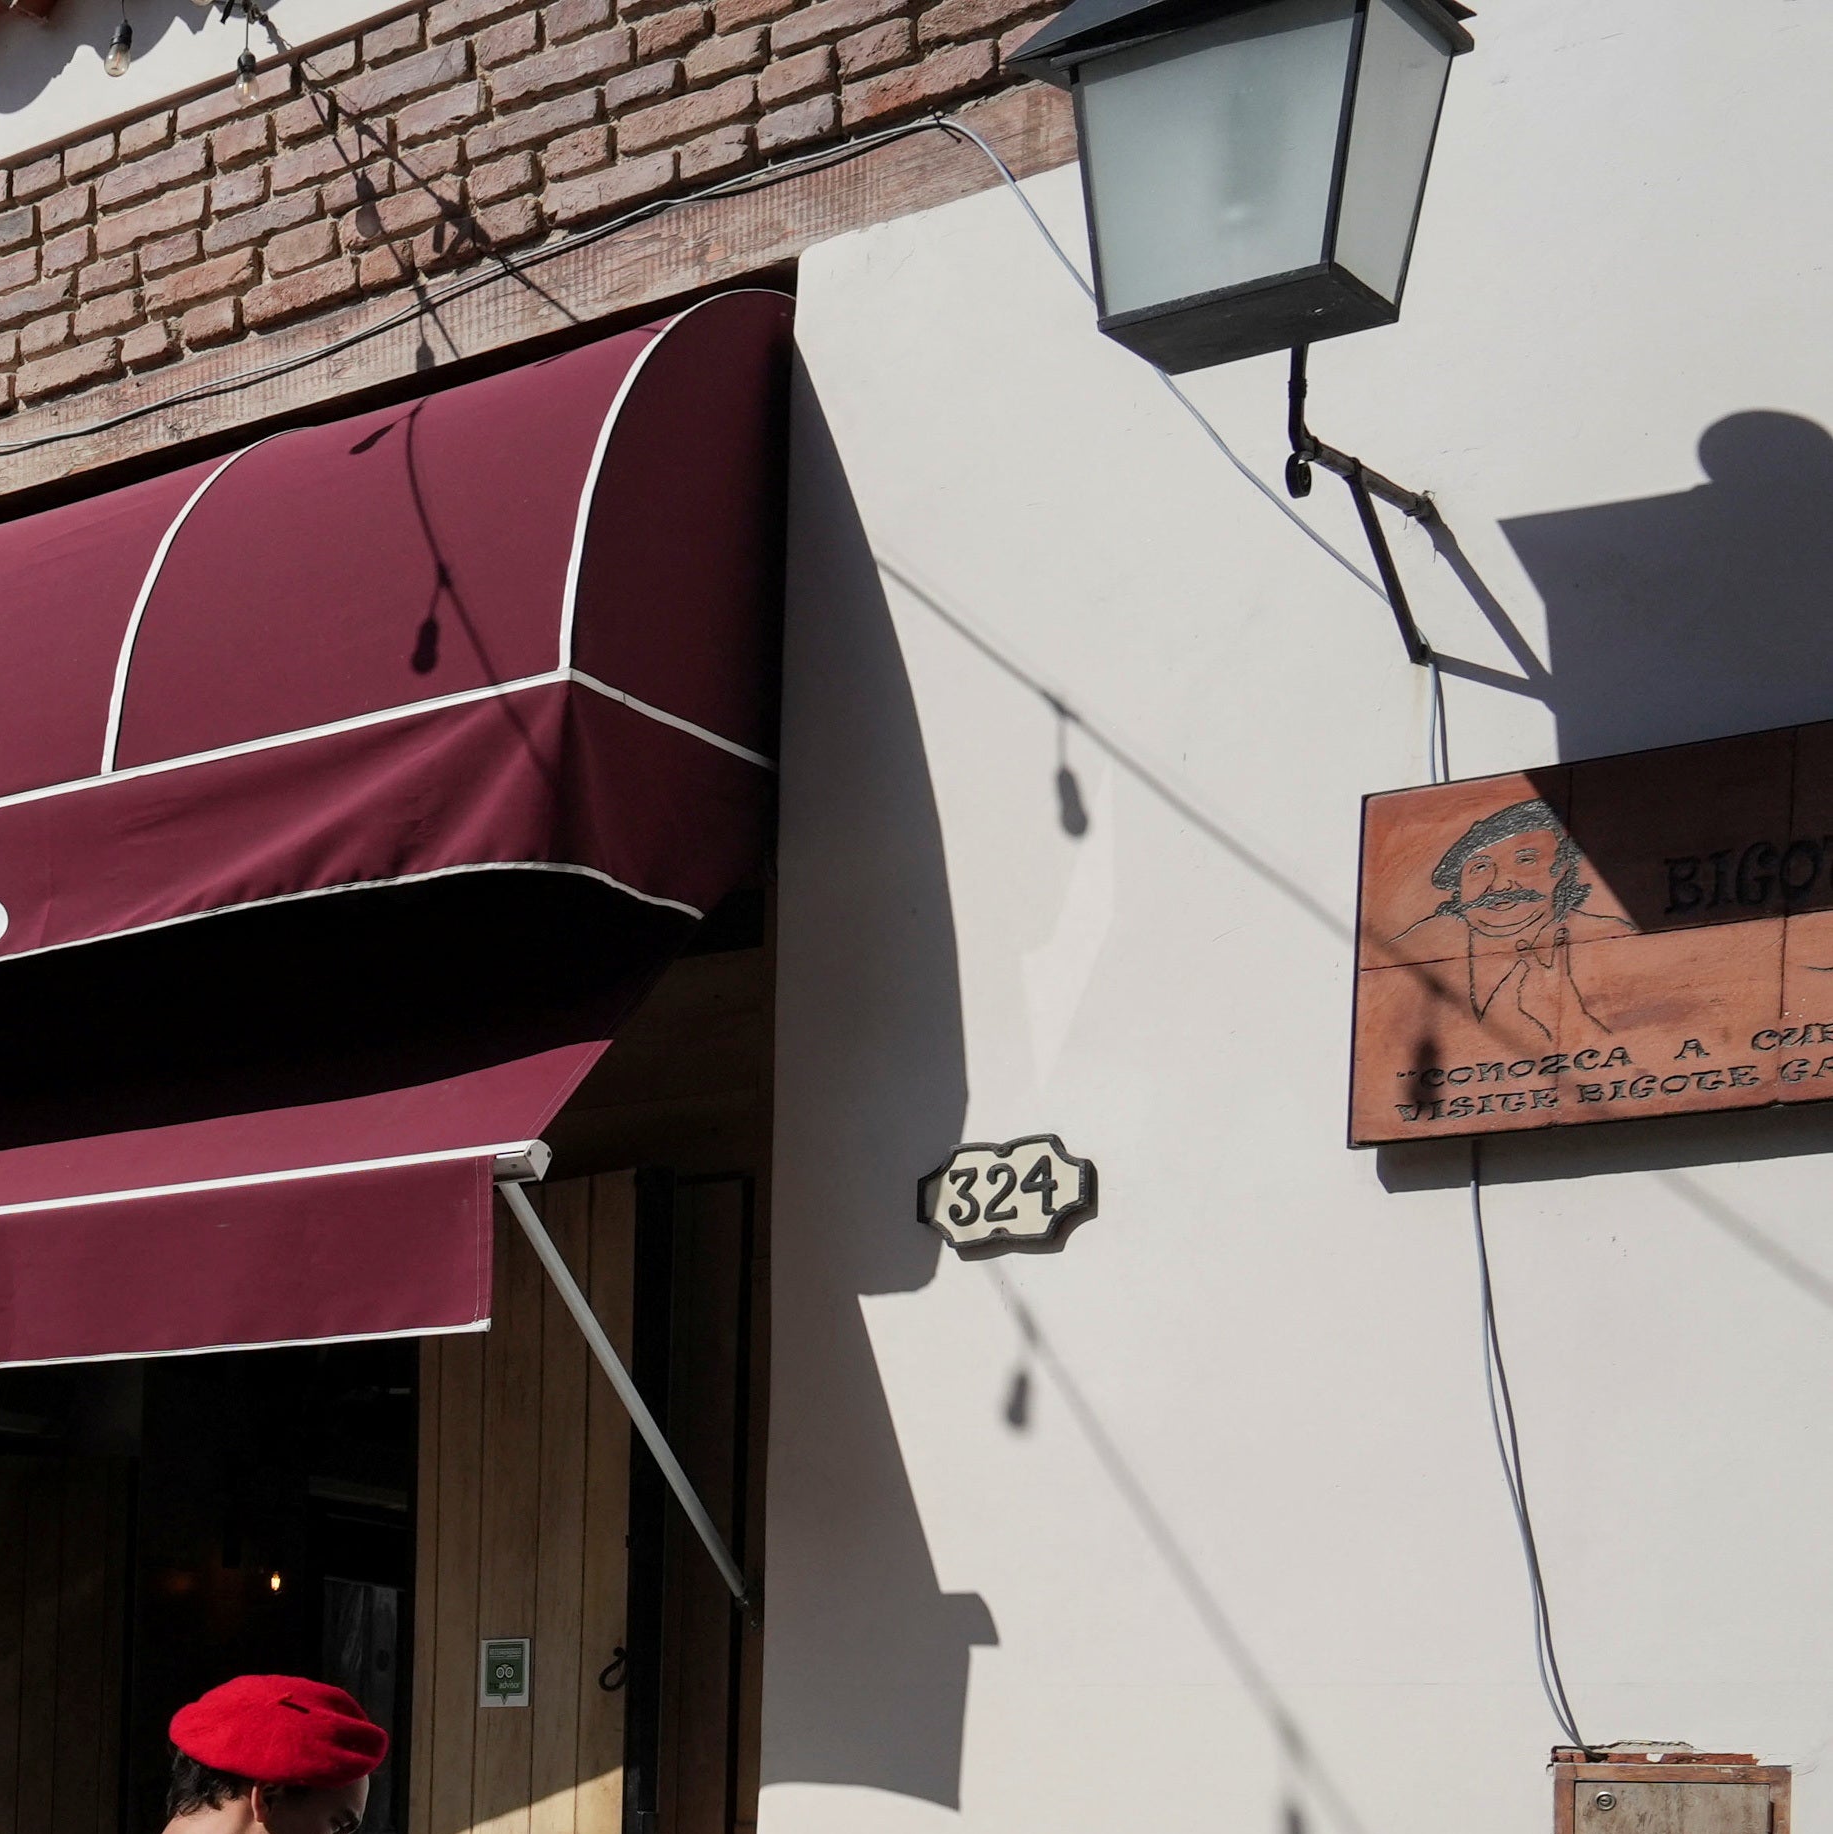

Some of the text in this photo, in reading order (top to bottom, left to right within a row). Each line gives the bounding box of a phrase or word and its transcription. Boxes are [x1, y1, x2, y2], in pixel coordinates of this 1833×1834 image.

[1674, 1038, 1711, 1060] A
[1395, 1056, 1833, 1122] VISITE BIGOTE GA
[948, 1154, 1058, 1227] 324
